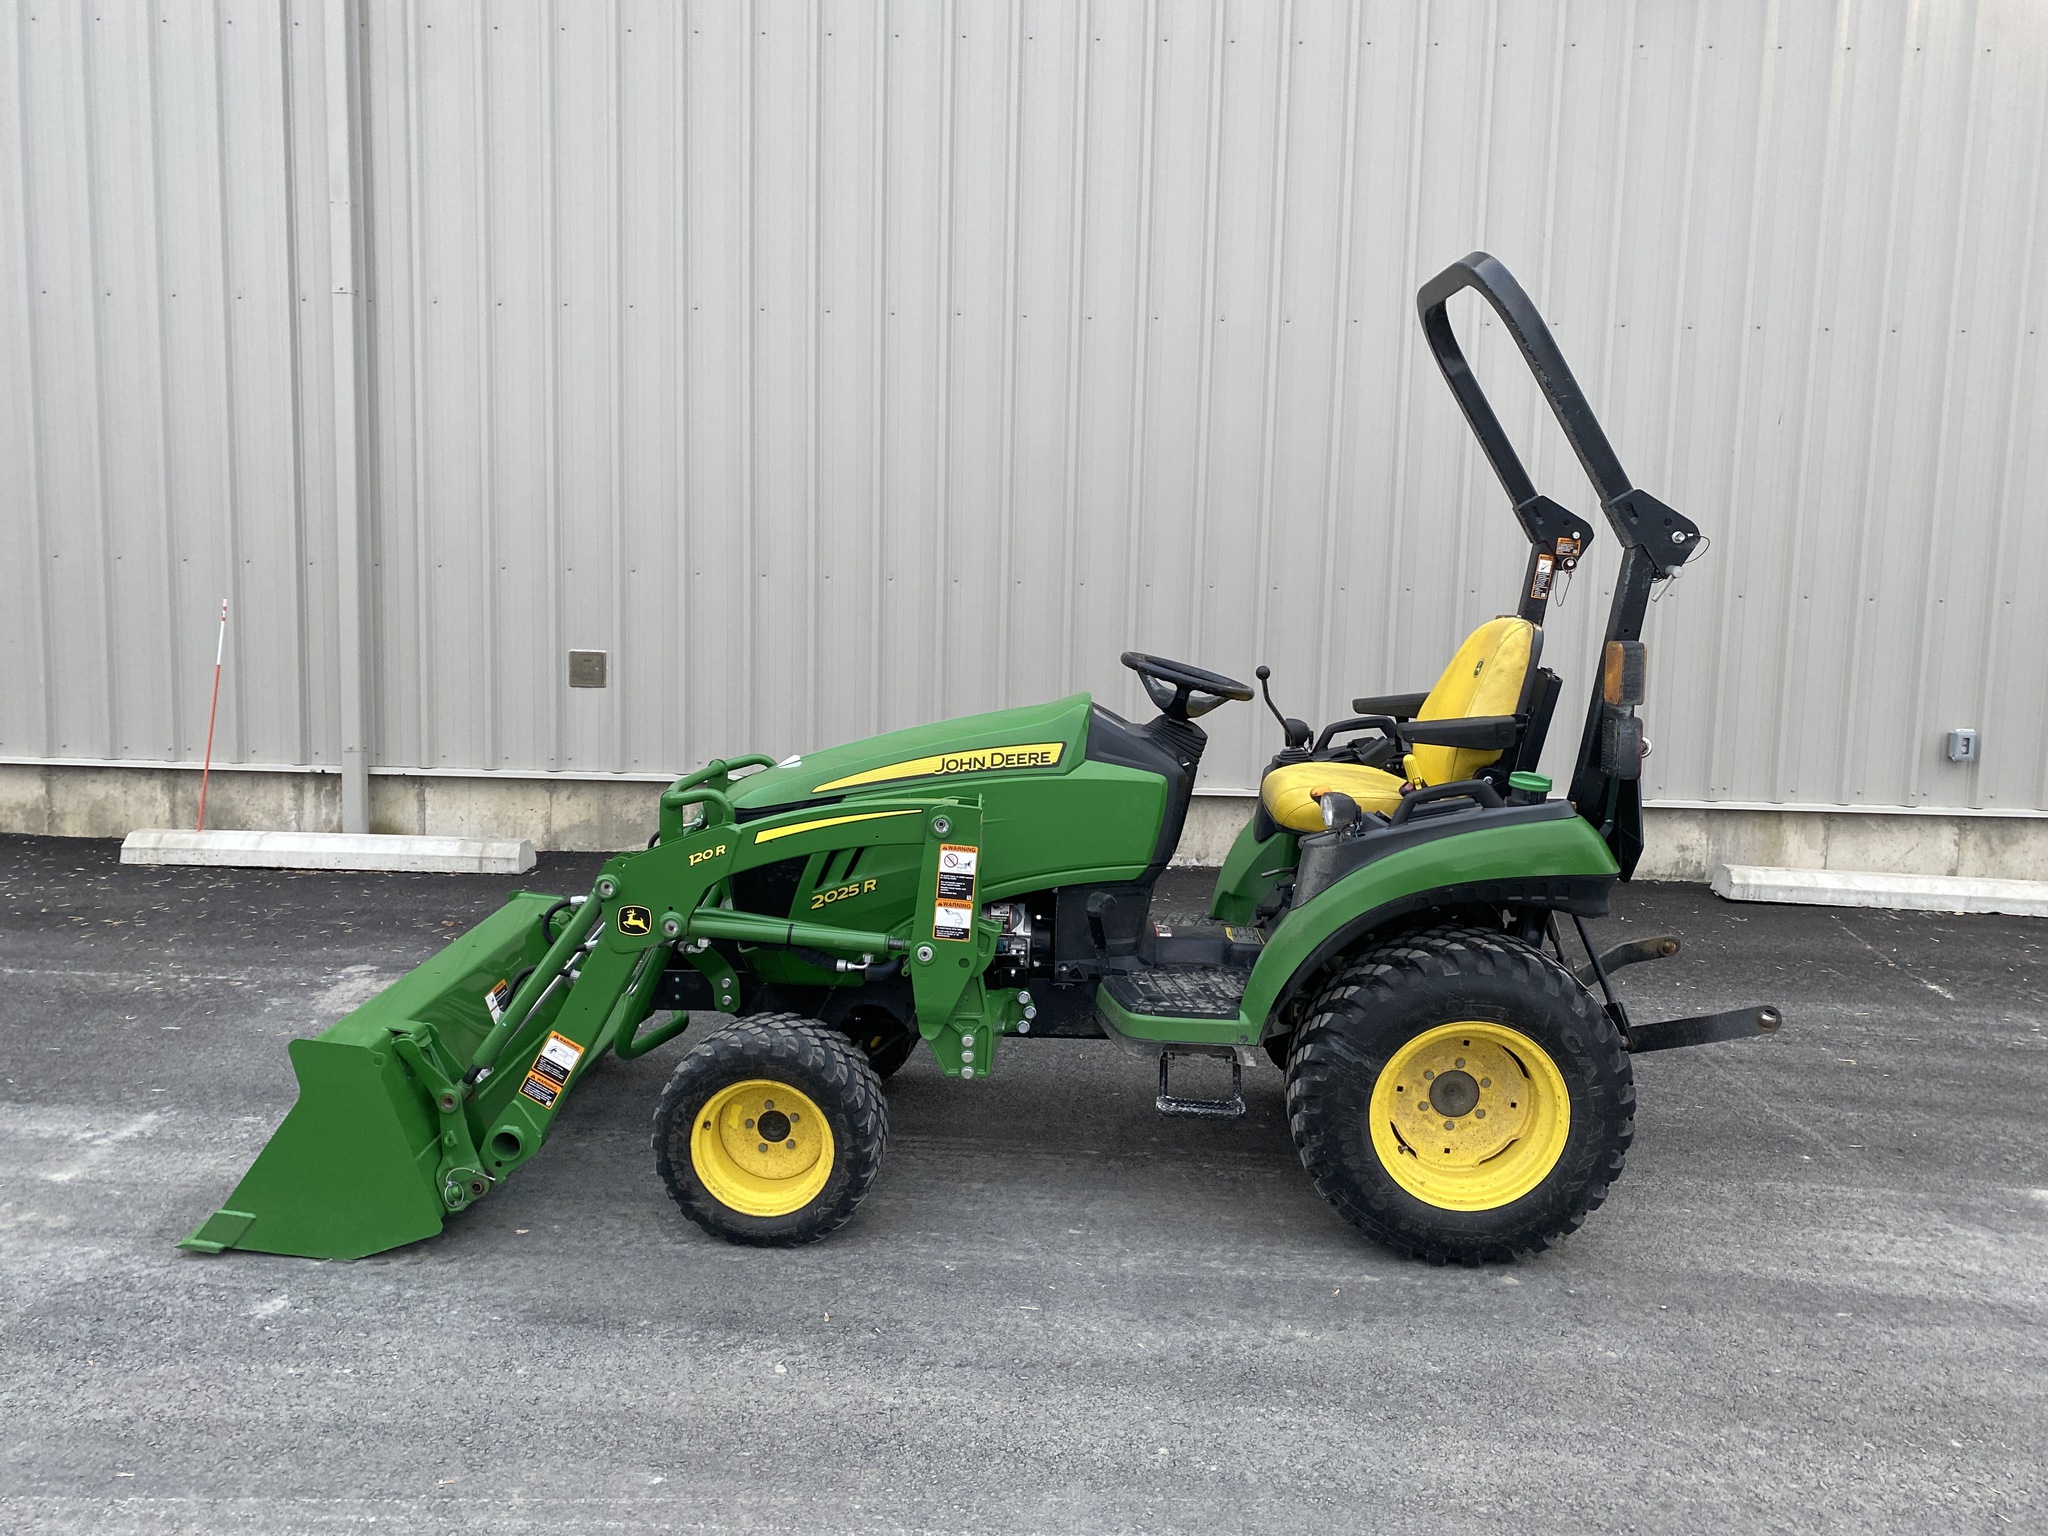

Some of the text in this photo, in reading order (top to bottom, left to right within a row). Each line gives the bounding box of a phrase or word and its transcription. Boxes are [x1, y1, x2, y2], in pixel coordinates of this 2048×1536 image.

[934, 751, 1051, 773] JOHN DEERE
[688, 844, 727, 867] 120 R
[947, 845, 976, 853] WARNING
[811, 879, 877, 910] 2025 R
[942, 900, 971, 909] WARNING
